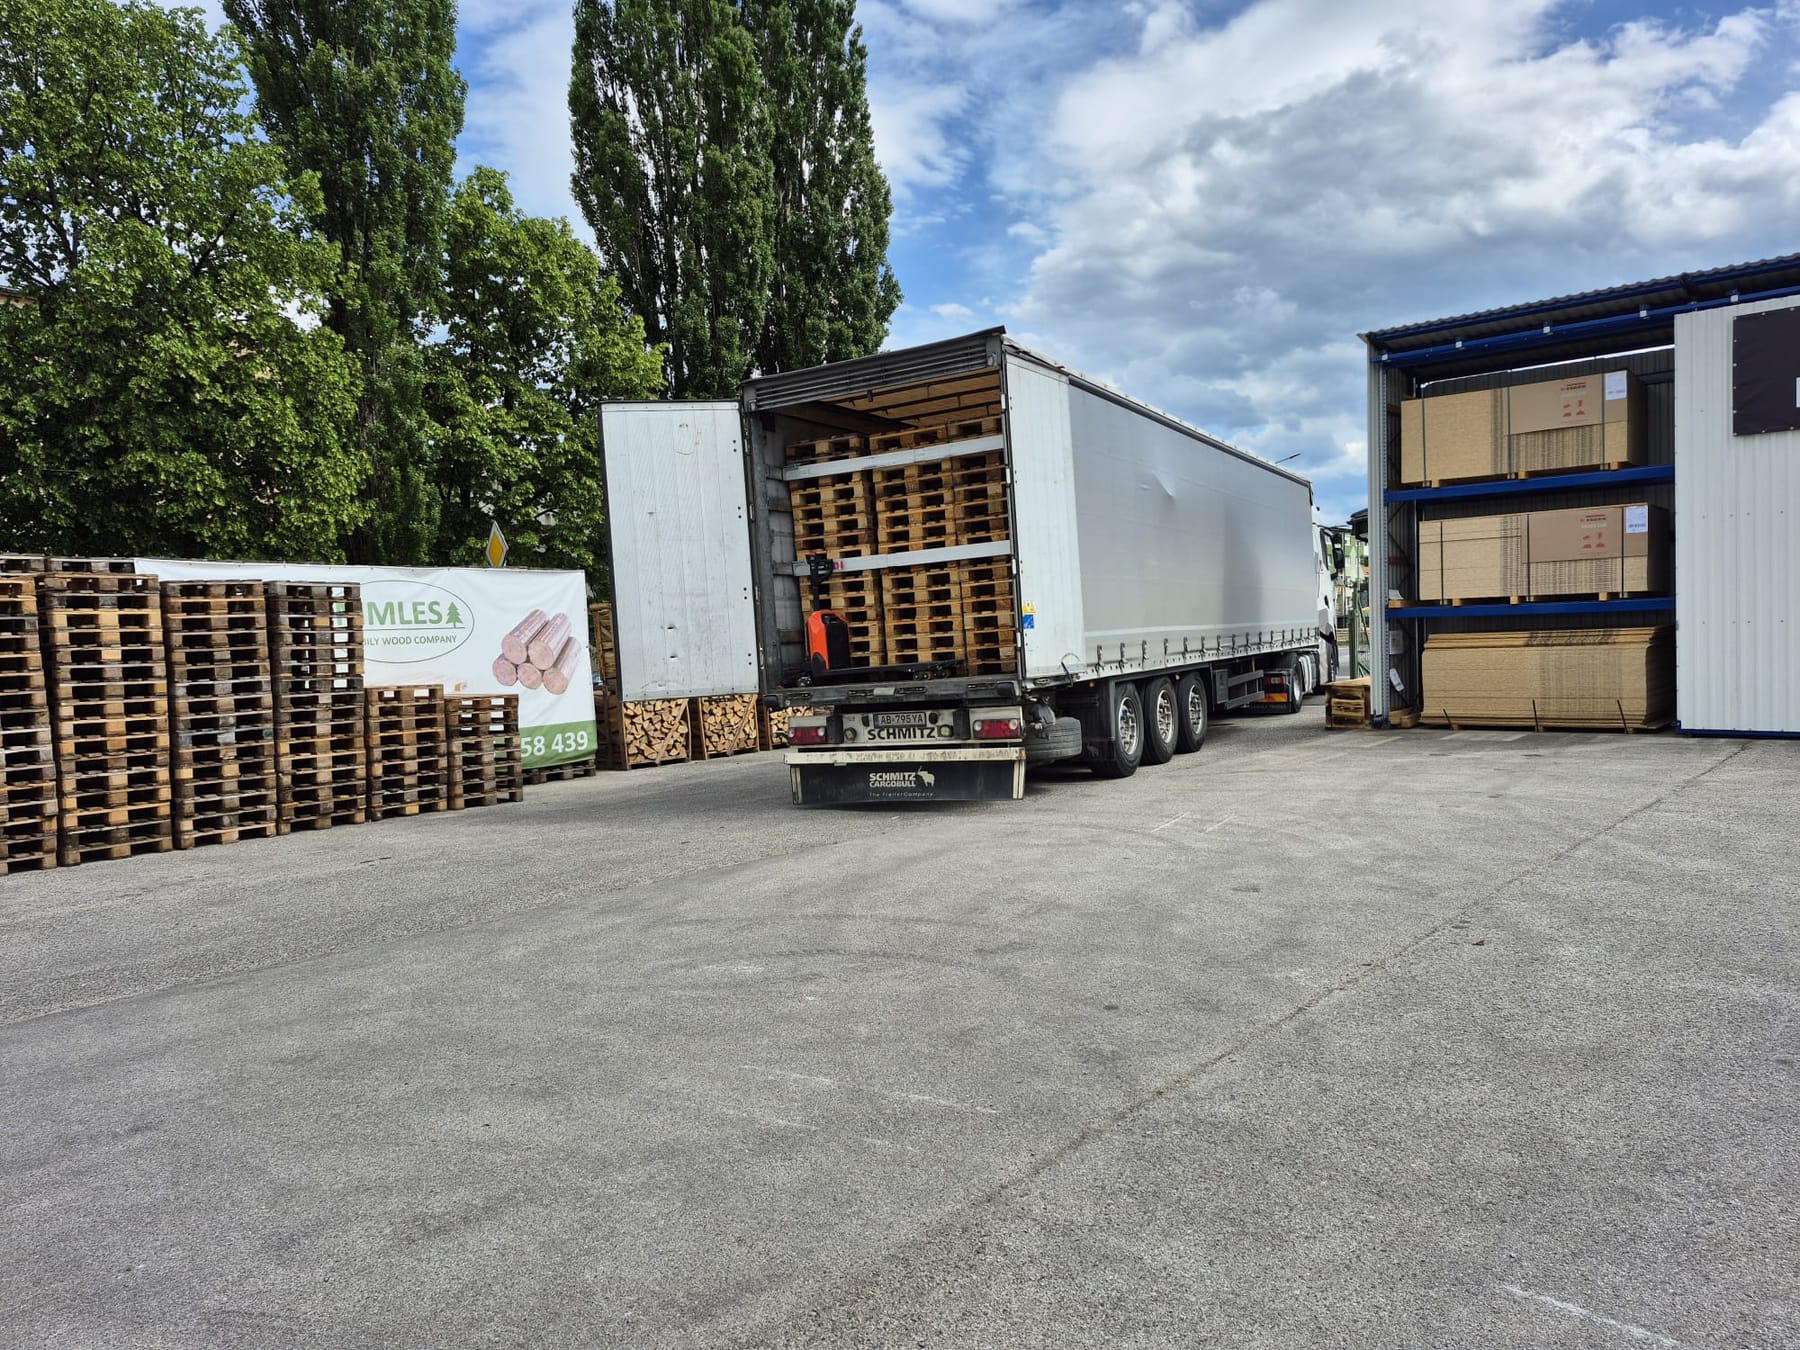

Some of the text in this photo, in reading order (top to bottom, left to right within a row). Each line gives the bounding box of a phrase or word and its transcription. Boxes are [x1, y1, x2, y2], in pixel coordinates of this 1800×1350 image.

[366, 601, 443, 625] MLES
[364, 635, 457, 646] ILY WOOD COMPANY
[868, 727, 936, 740] SCHMITZ
[551, 731, 588, 753] 439
[869, 772, 916, 780] SCHMITZ
